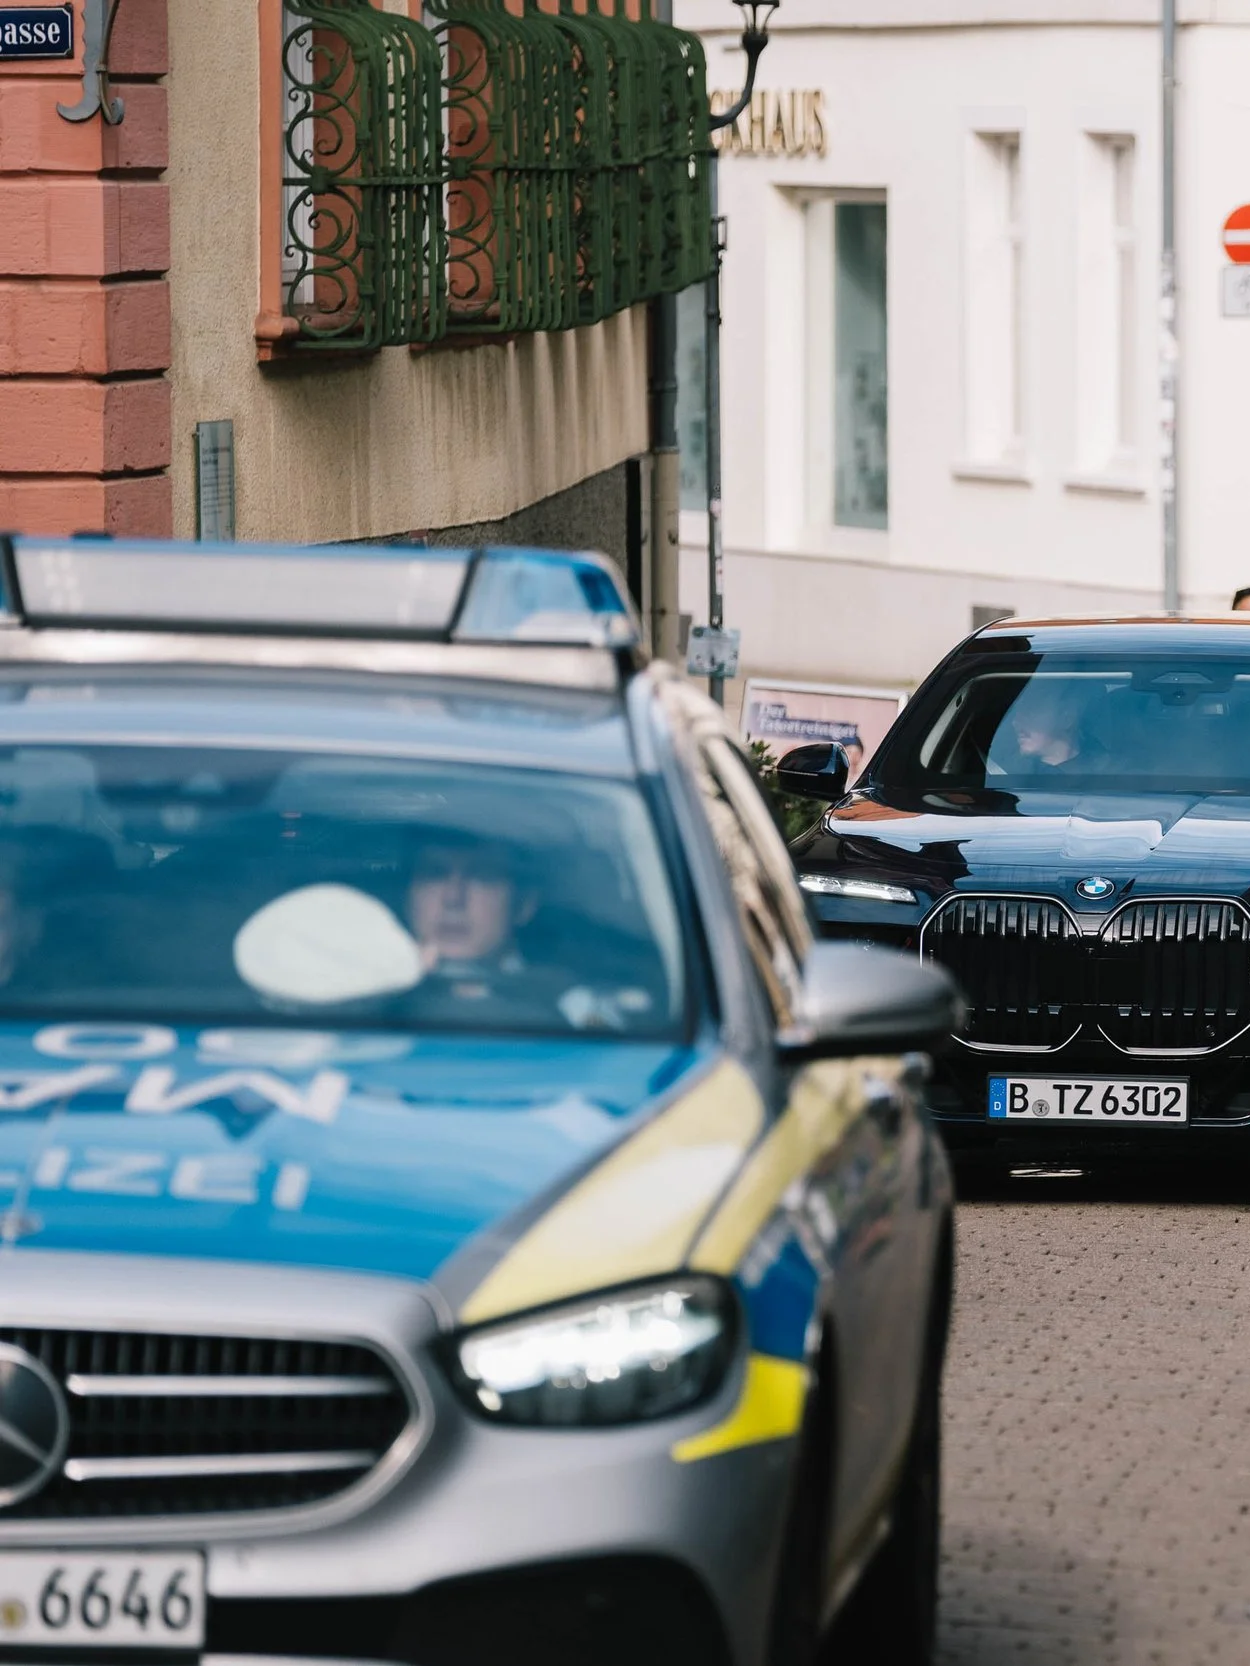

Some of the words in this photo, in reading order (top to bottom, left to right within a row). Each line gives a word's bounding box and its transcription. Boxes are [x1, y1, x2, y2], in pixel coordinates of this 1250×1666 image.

[0, 22, 60, 52] asse
[1009, 1082, 1029, 1113] B
[1052, 1084, 1093, 1115] TZ
[1101, 1085, 1182, 1117] 6302
[39, 1567, 193, 1631] 6646
